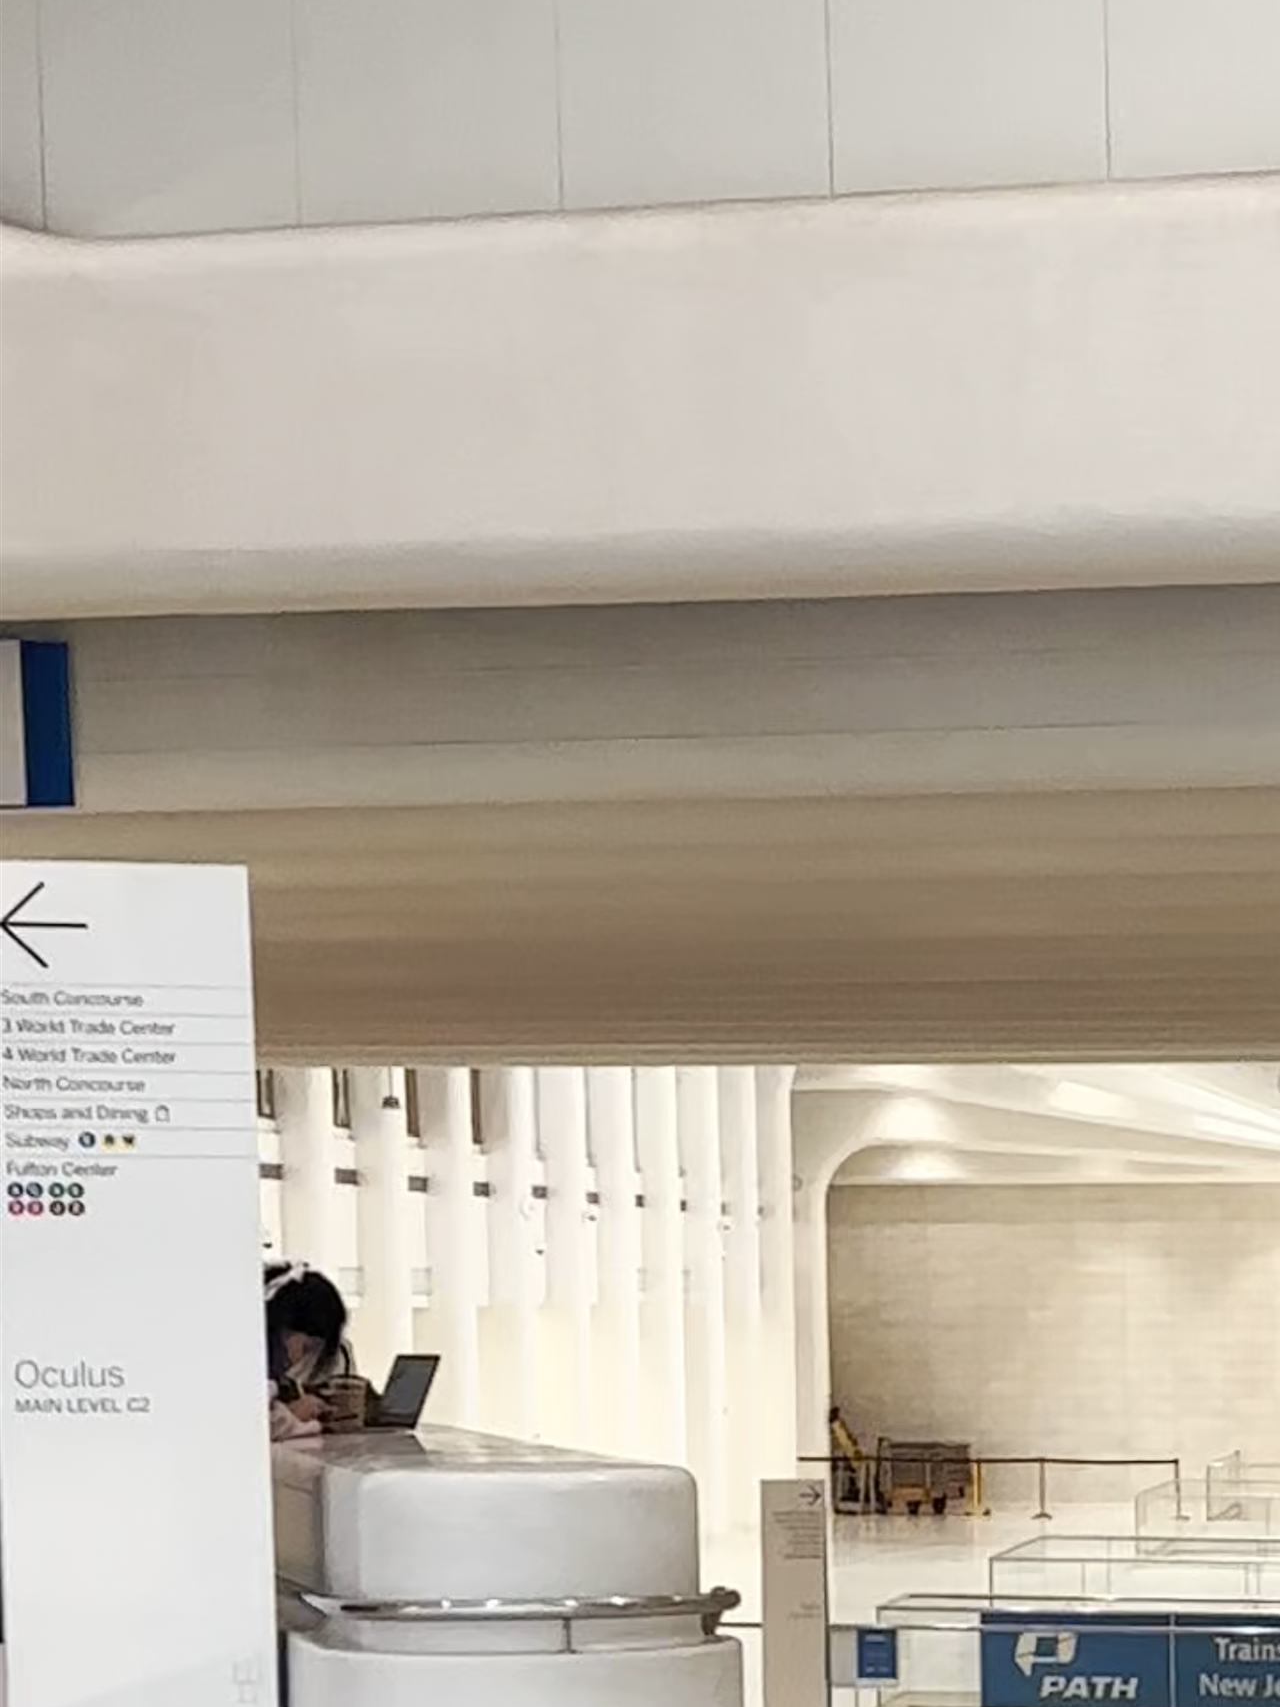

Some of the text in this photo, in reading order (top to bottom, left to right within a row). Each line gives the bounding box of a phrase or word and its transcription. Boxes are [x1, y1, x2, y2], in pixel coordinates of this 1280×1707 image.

[53, 990, 145, 1007] Concourse
[15, 1018, 65, 1034] World
[69, 1018, 116, 1035] Trade
[119, 1020, 175, 1035] Center
[2, 1045, 176, 1064] 4 World Trade Center
[3, 1075, 146, 1091] North Concourse
[4, 1105, 149, 1123] Shops and Dining
[5, 1133, 69, 1151] Subway
[6, 1160, 118, 1177] Fulton Center
[15, 1359, 125, 1389] Oculus
[15, 1396, 151, 1414] MAIN LEVEL C2
[1039, 1676, 1139, 1700] PATH
[1199, 1672, 1256, 1698] New
